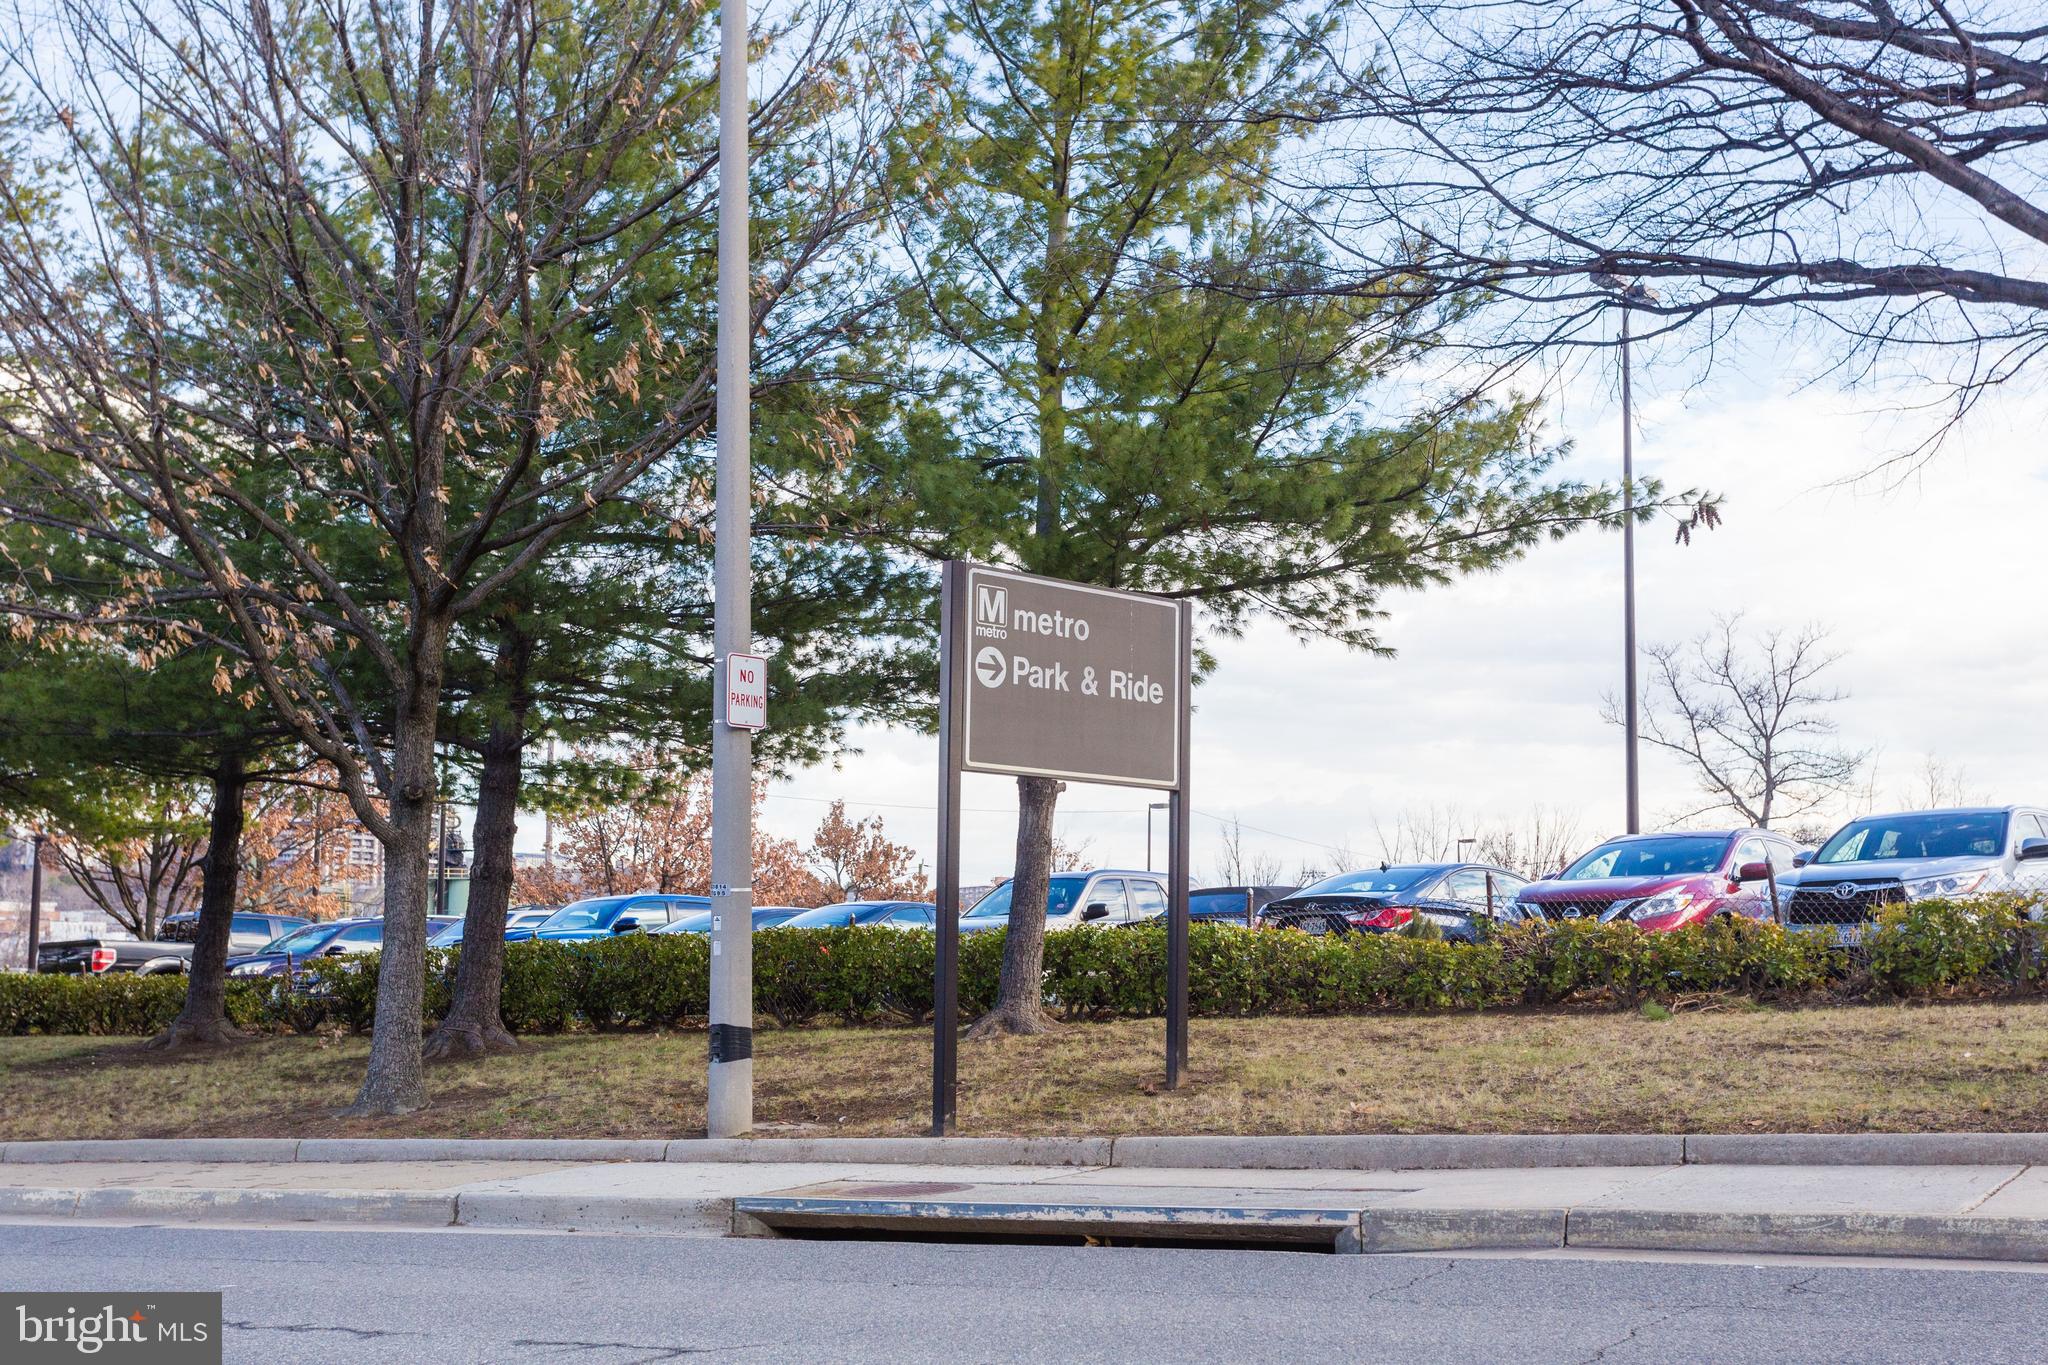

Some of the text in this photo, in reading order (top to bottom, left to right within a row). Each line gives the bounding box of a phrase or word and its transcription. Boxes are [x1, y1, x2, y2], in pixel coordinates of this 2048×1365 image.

[976, 626, 1007, 640] metro
[1014, 609, 1090, 641] metro
[740, 669, 754, 683] NO
[1013, 656, 1164, 704] Park & Ride
[730, 692, 764, 709] PARKING
